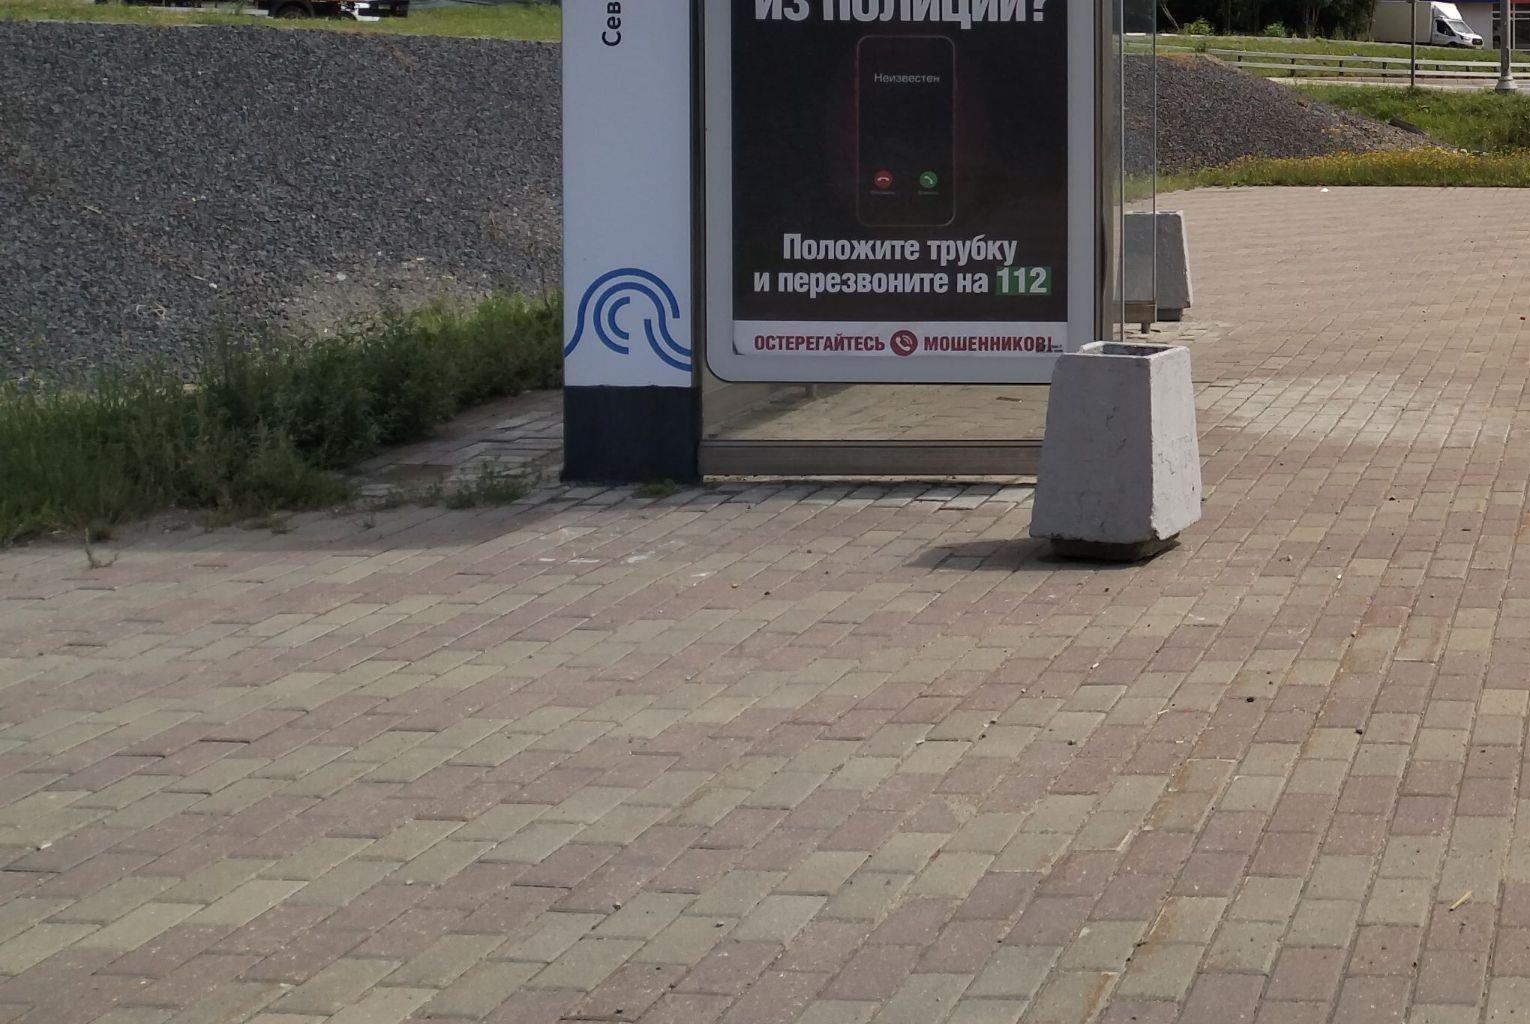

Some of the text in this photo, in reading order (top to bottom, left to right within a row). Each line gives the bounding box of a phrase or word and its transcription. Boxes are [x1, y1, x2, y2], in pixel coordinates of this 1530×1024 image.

[874, 73, 941, 83] Неизвестен
[783, 232, 1018, 266] Положите трубку
[753, 267, 1048, 299] и перезвоните на 112
[754, 333, 886, 351] ОСТЕРЕГАЙТЕСЬ
